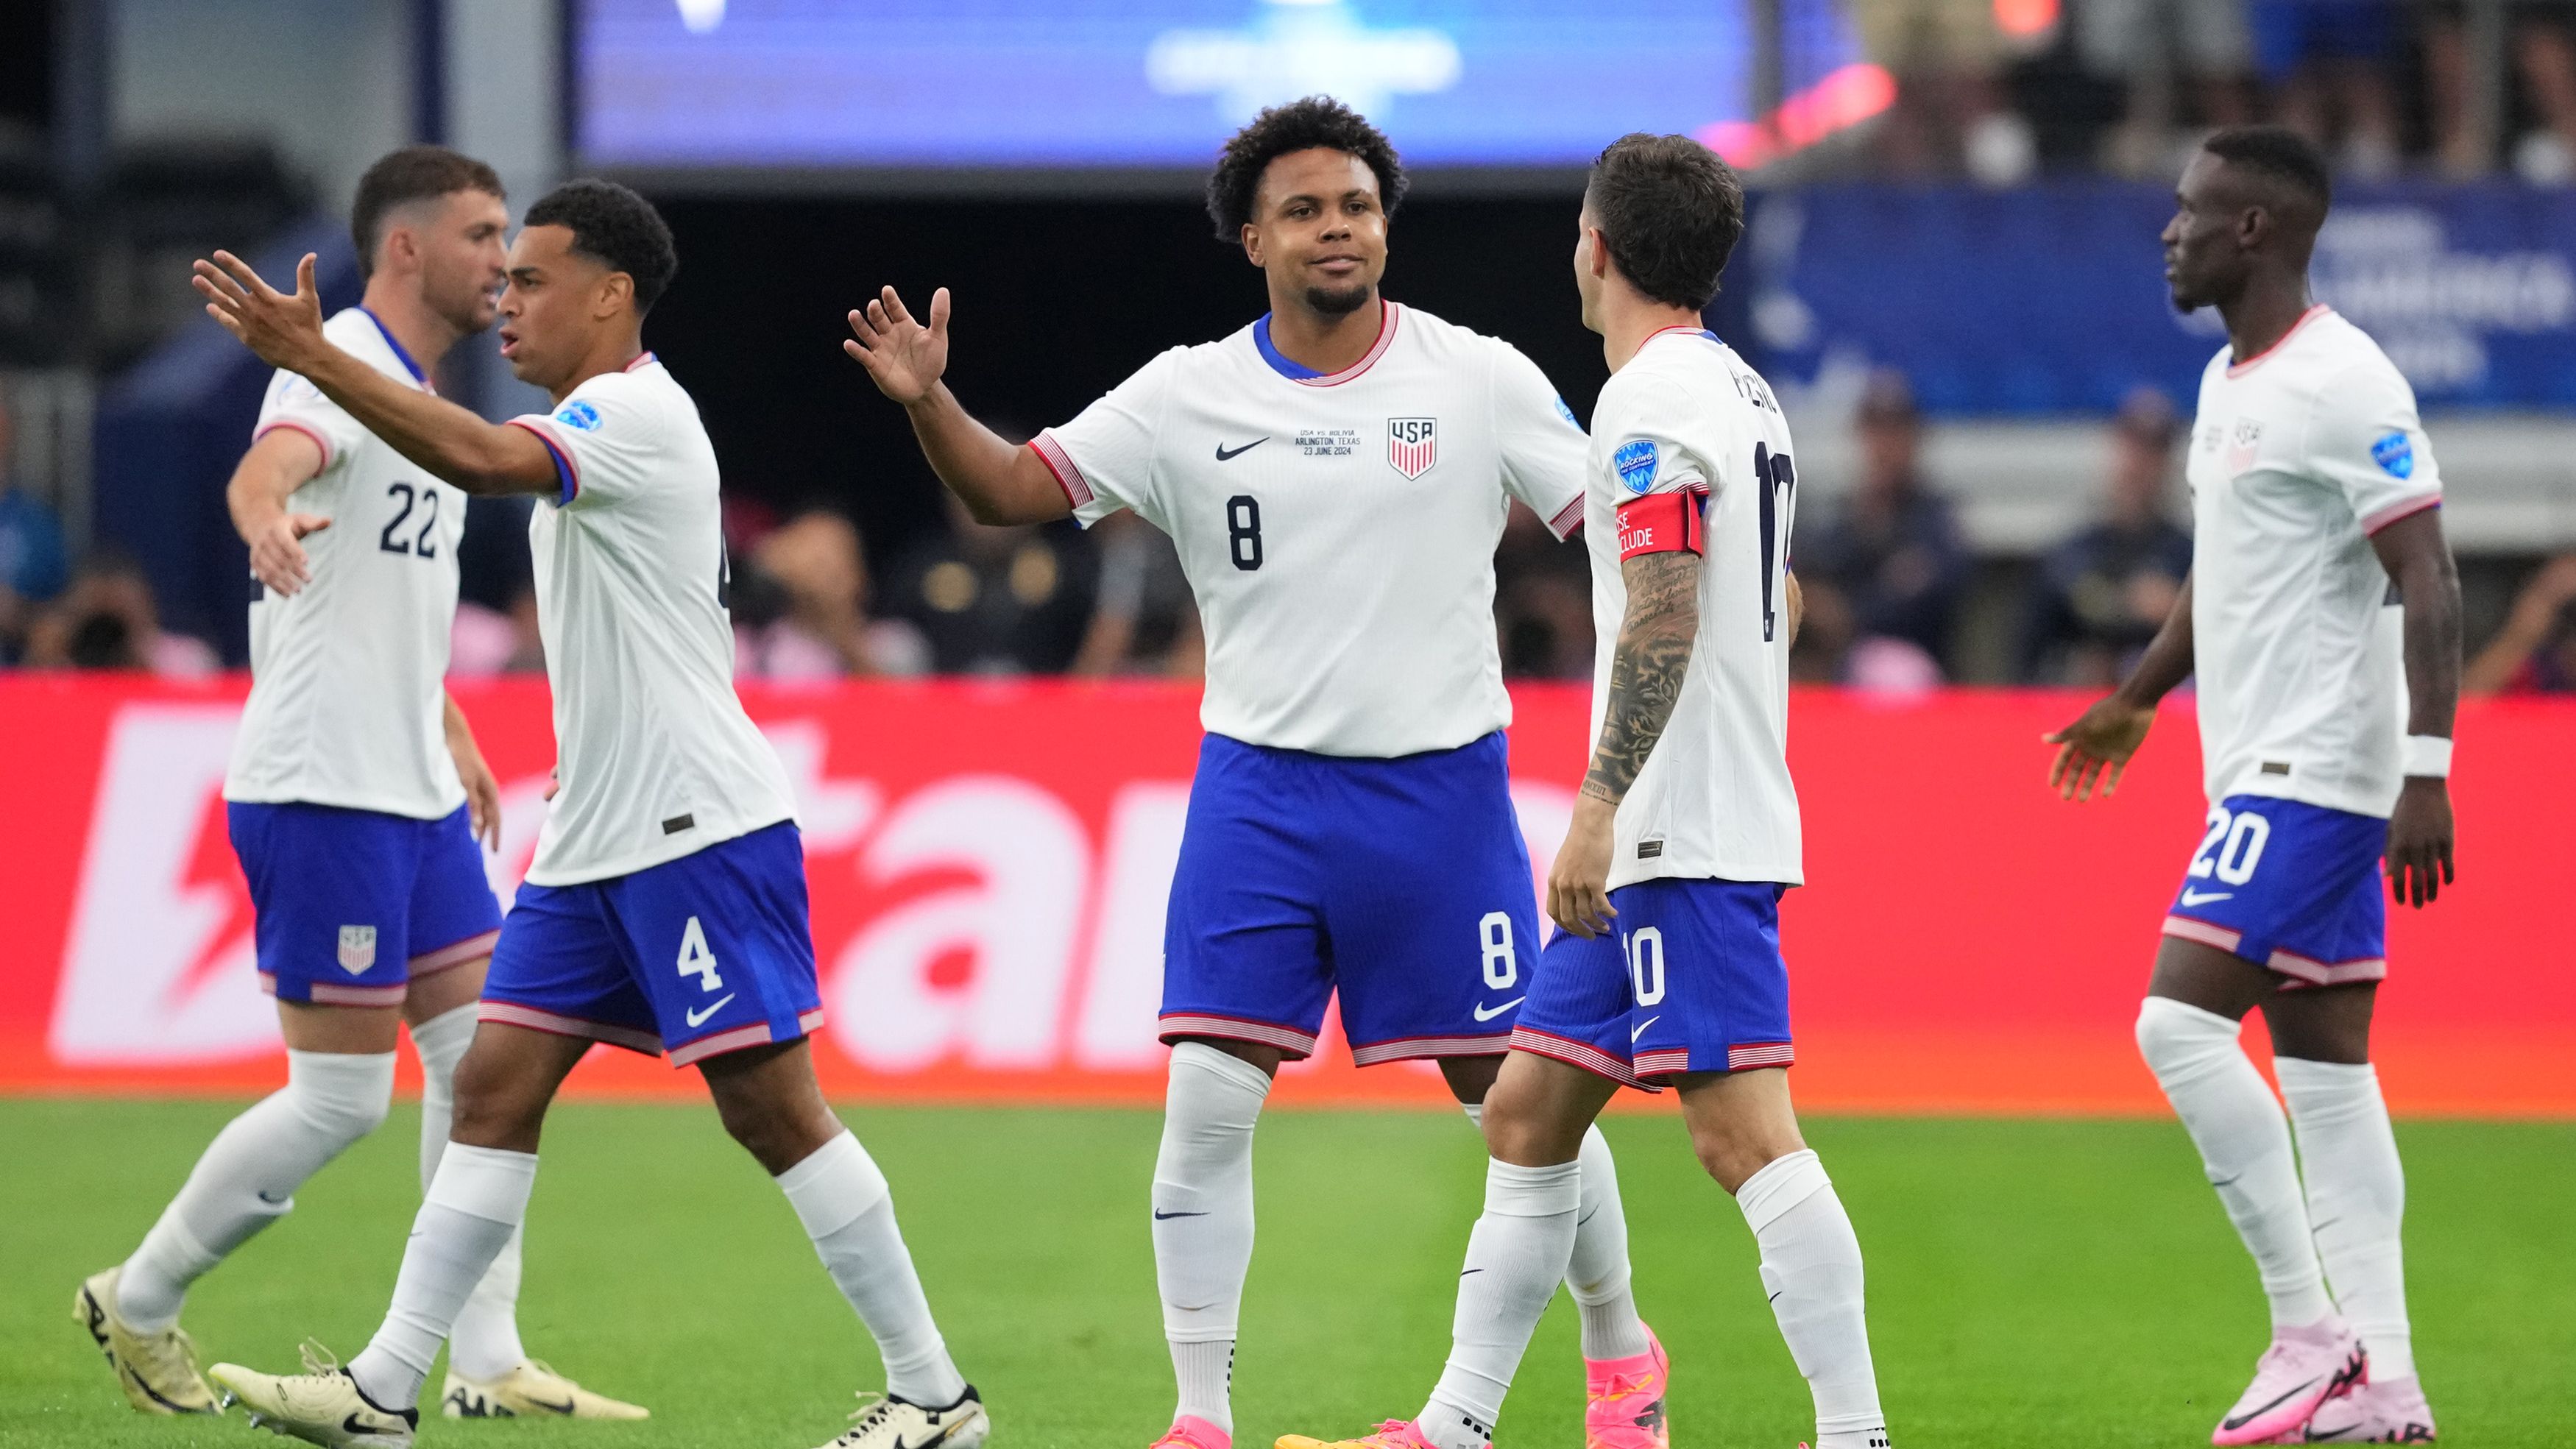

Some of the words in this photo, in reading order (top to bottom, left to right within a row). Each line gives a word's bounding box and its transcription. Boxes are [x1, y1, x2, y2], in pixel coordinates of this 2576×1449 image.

[1303, 447, 1313, 456] 23
[1314, 447, 1332, 456] JUNE
[1334, 447, 1351, 455] 2024
[1337, 437, 1361, 445] TEXAS
[1393, 422, 1433, 444] USA
[1621, 453, 1653, 469] ROCKING
[381, 482, 439, 559] 22
[1226, 495, 1264, 571] 8
[2186, 807, 2271, 886] 20
[676, 915, 723, 993] 4
[1479, 910, 1518, 991] 8
